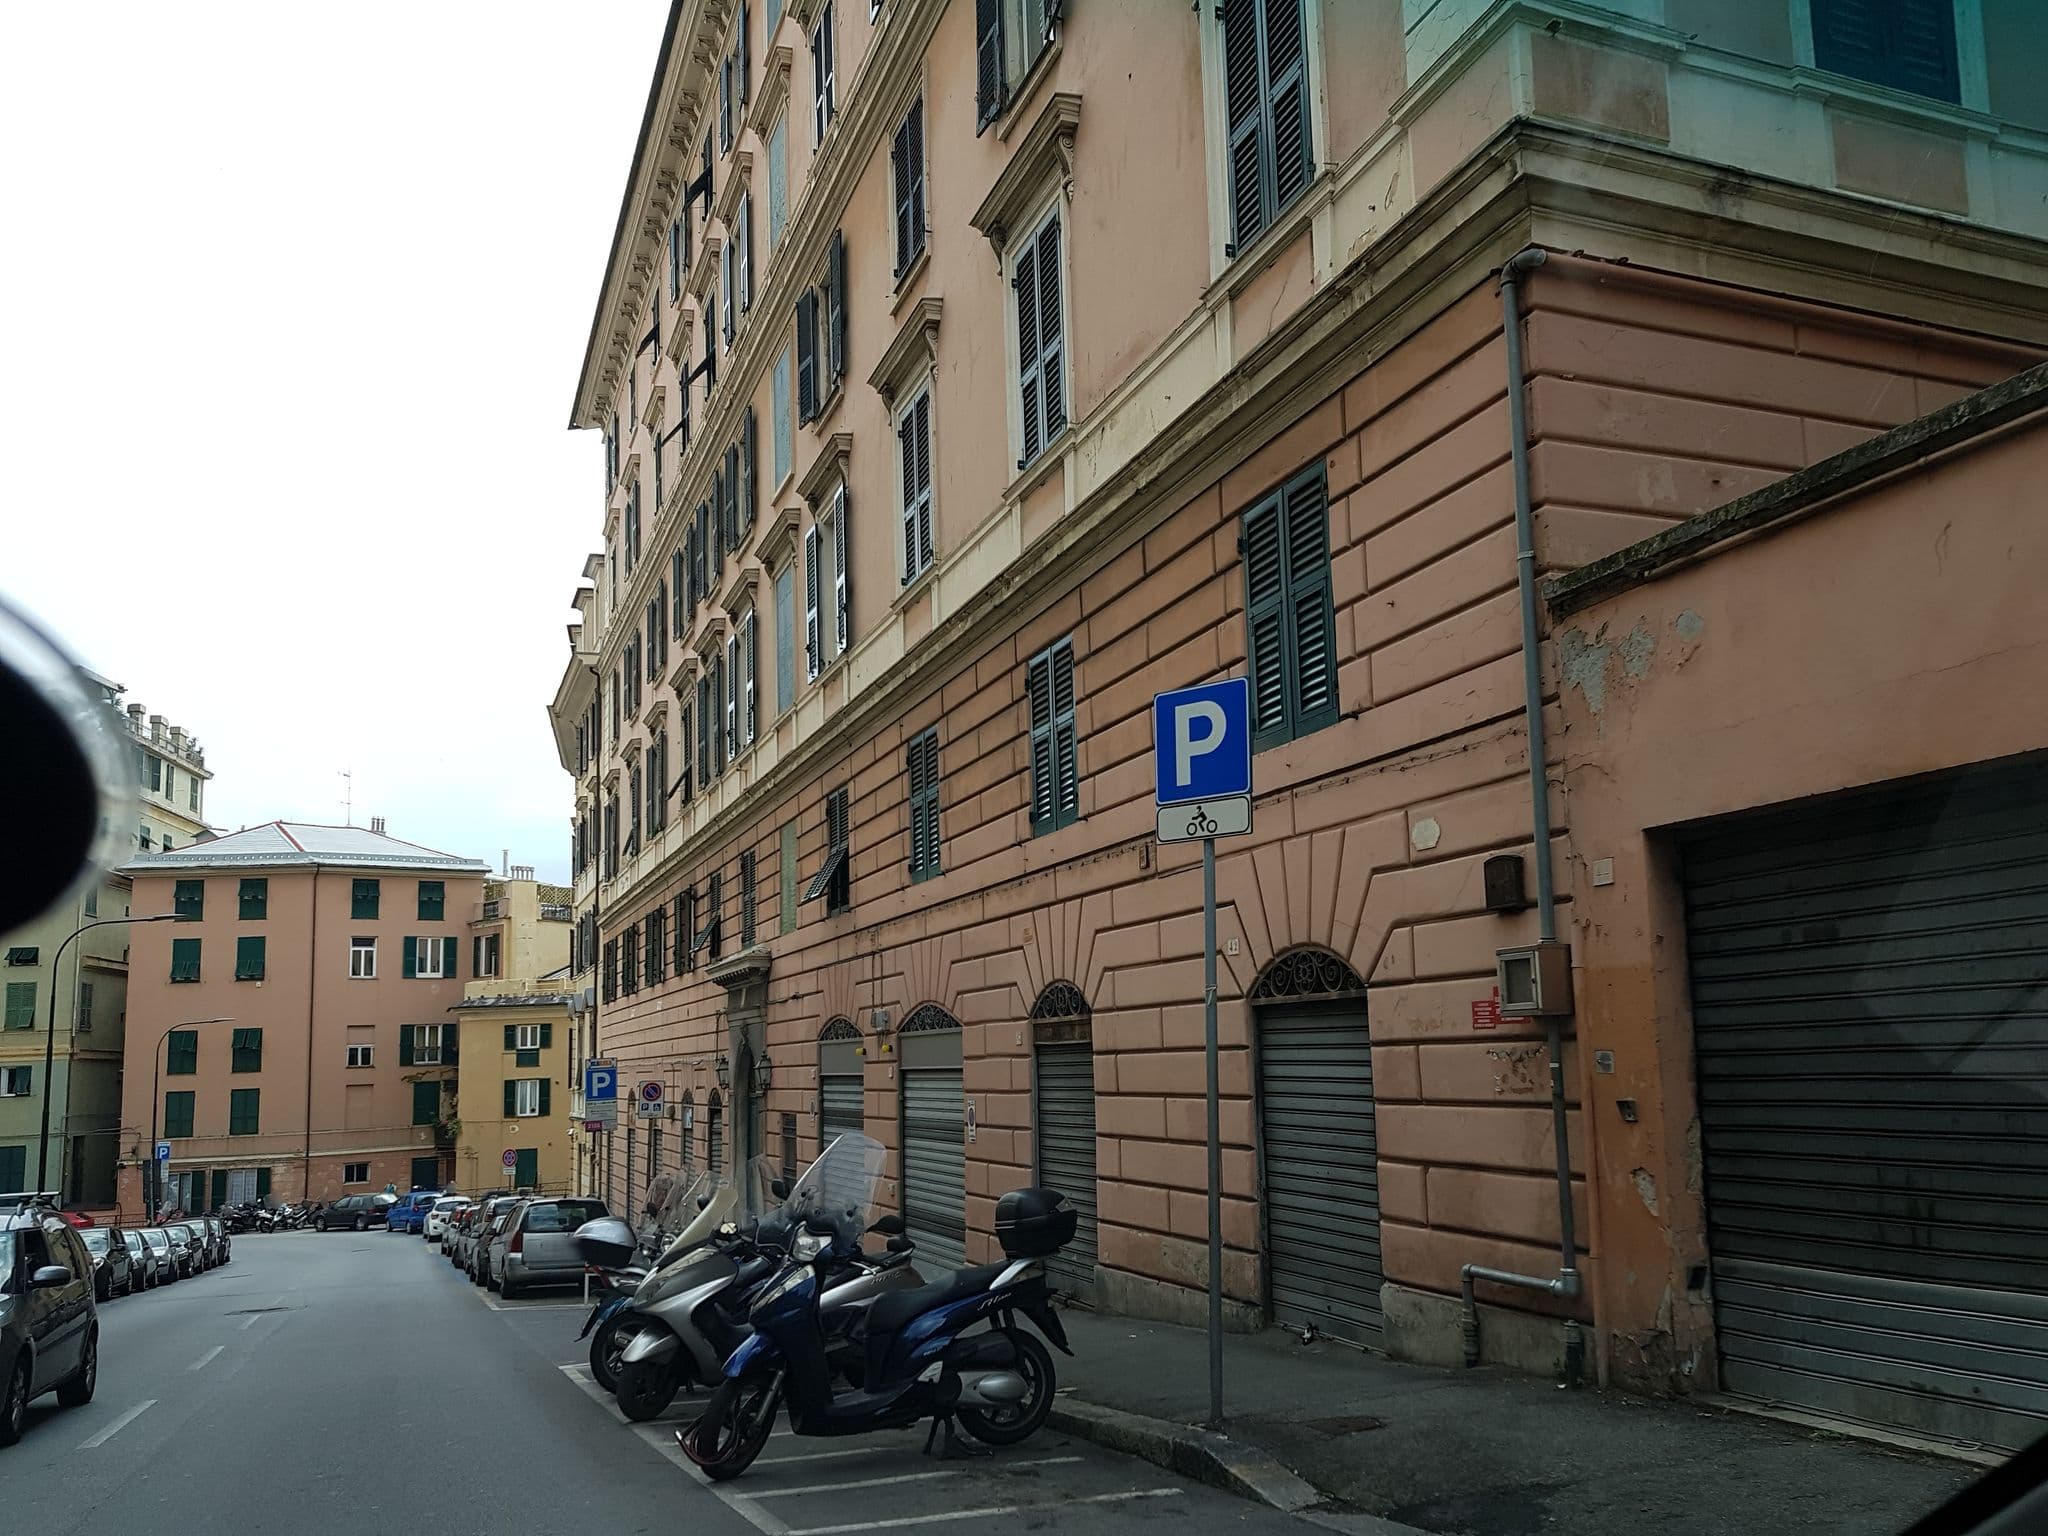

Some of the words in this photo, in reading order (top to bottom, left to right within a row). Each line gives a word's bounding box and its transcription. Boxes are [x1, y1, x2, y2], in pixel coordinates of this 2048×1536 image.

[1175, 700, 1227, 787] P
[592, 1072, 610, 1096] P
[160, 1147, 168, 1159] P
